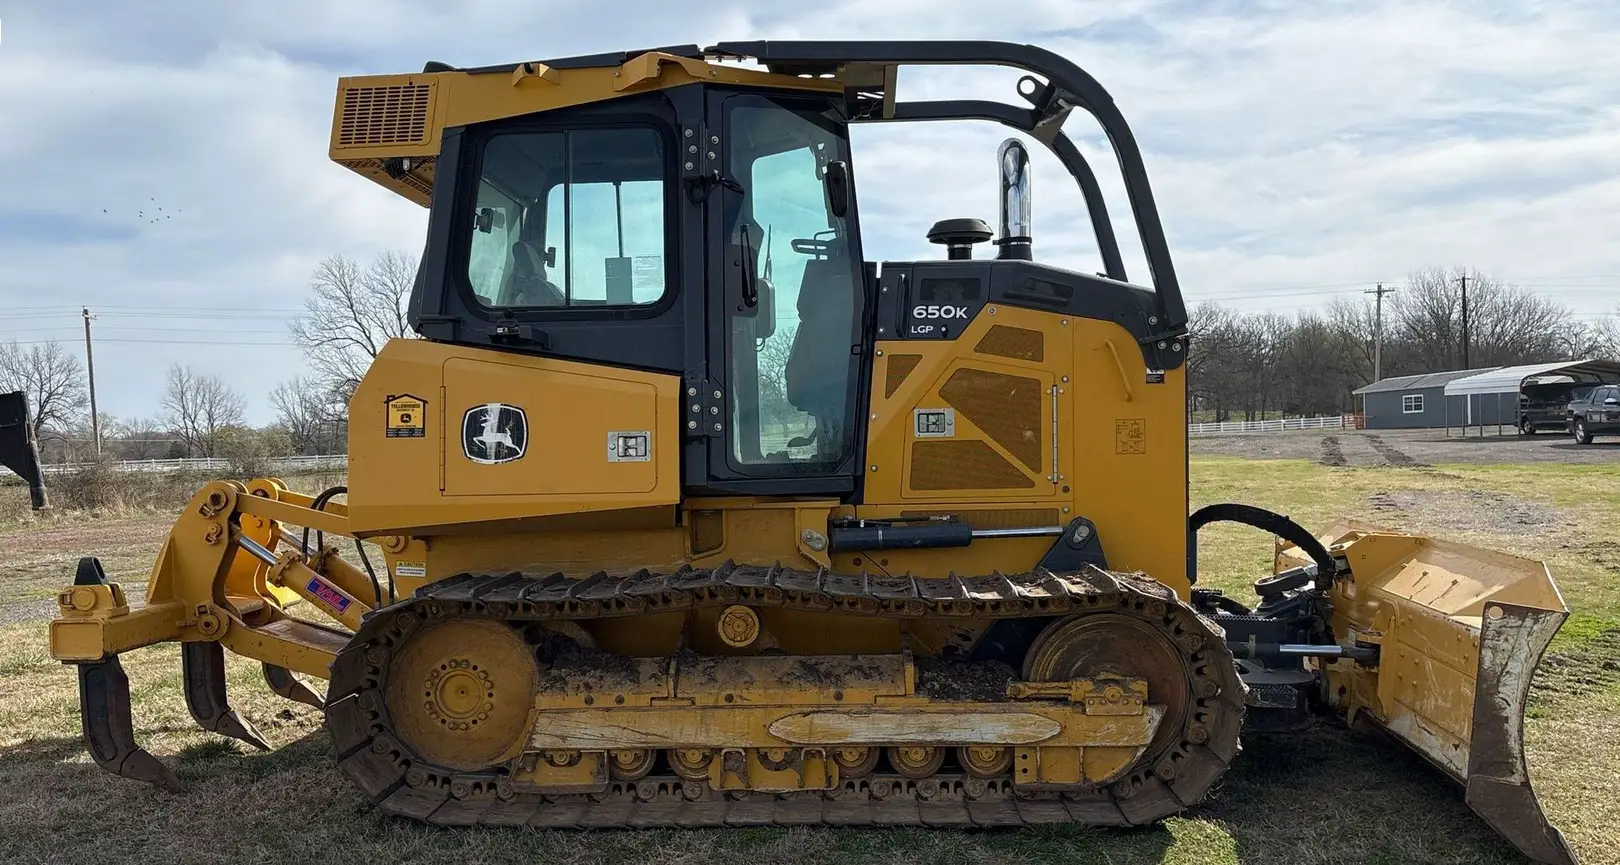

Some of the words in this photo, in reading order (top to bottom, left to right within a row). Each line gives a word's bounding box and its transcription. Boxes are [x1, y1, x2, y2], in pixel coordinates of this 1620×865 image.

[913, 305, 968, 319] 650K
[911, 325, 934, 334] LGP
[313, 579, 344, 609] VAIL
